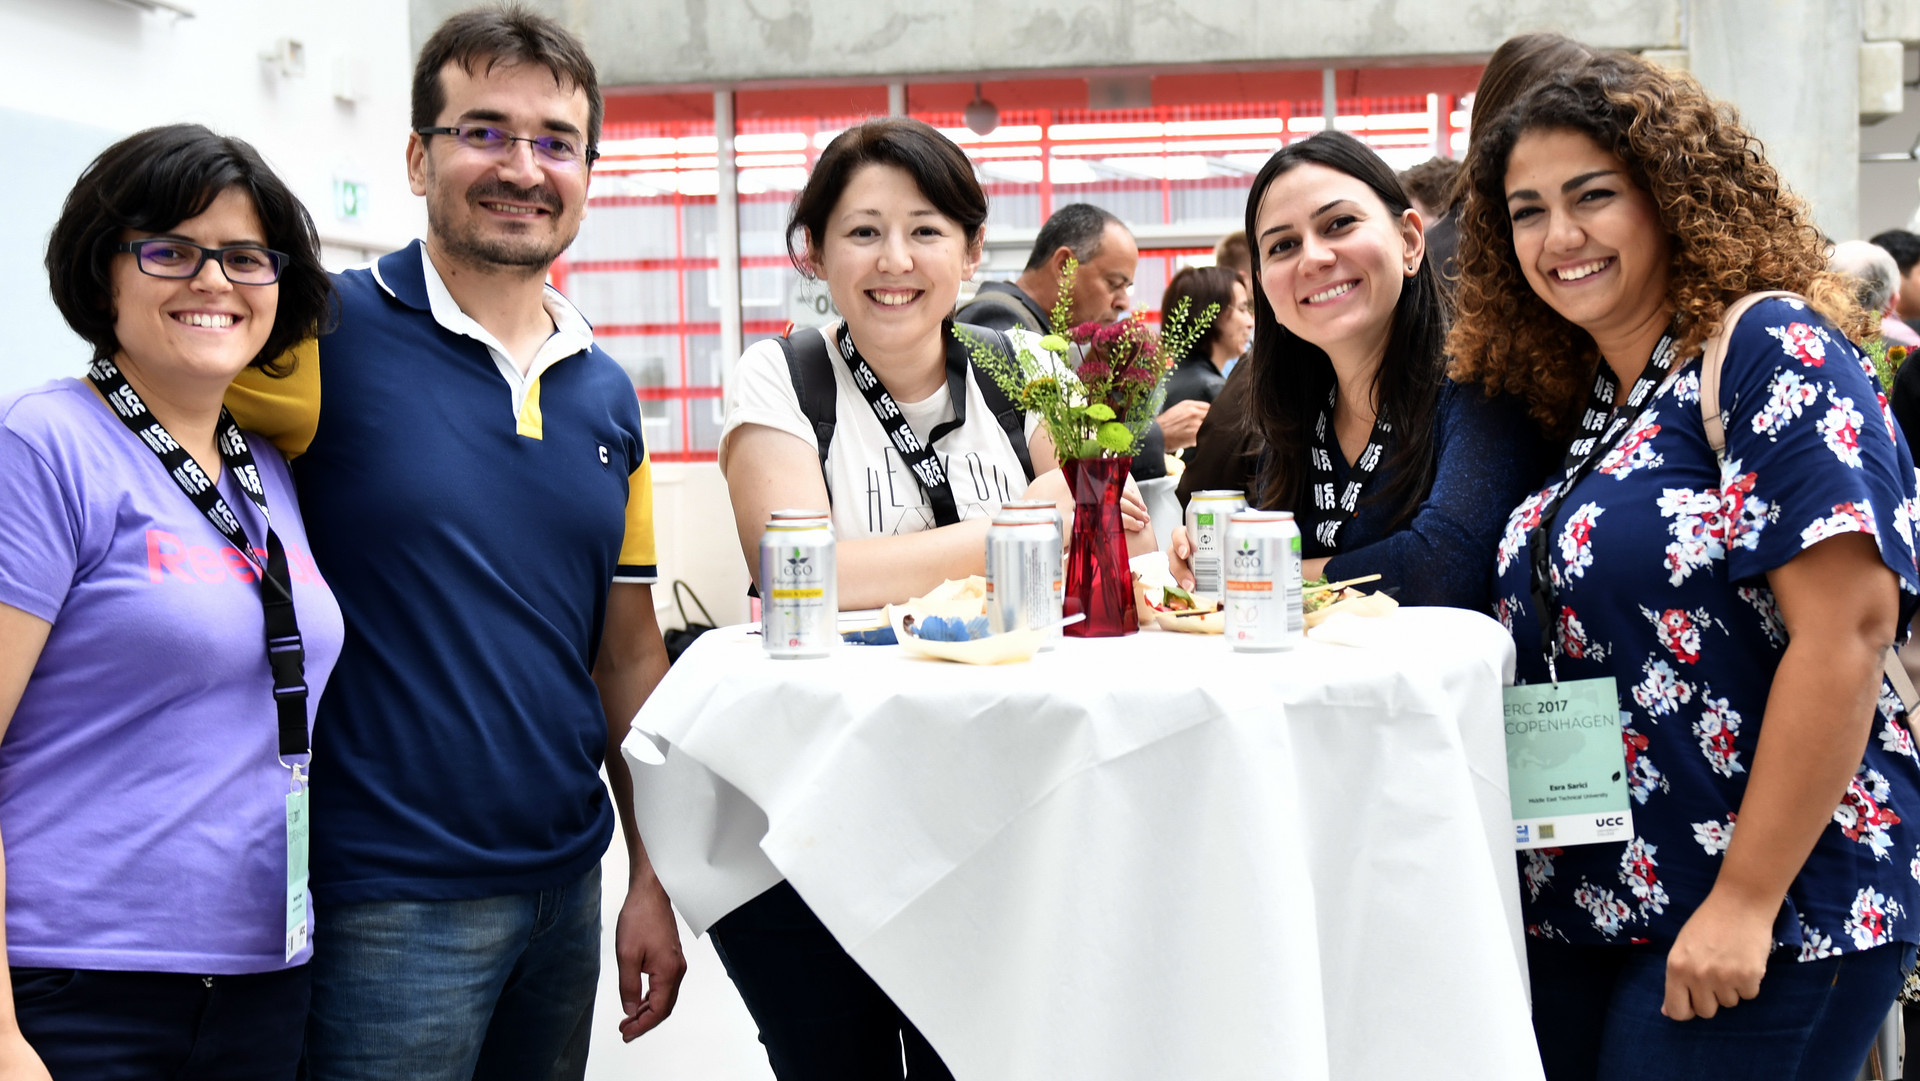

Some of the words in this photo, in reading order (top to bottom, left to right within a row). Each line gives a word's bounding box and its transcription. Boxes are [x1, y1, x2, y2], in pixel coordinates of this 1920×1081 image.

[118, 383, 147, 416] UCC
[149, 423, 180, 452] UCC
[226, 424, 248, 455] UCC
[182, 458, 212, 492] UCC
[215, 498, 240, 532] UCC
[1537, 700, 1568, 714] 2017
[1504, 715, 1615, 735] COPENHAGEN
[1596, 817, 1624, 827] UCC
